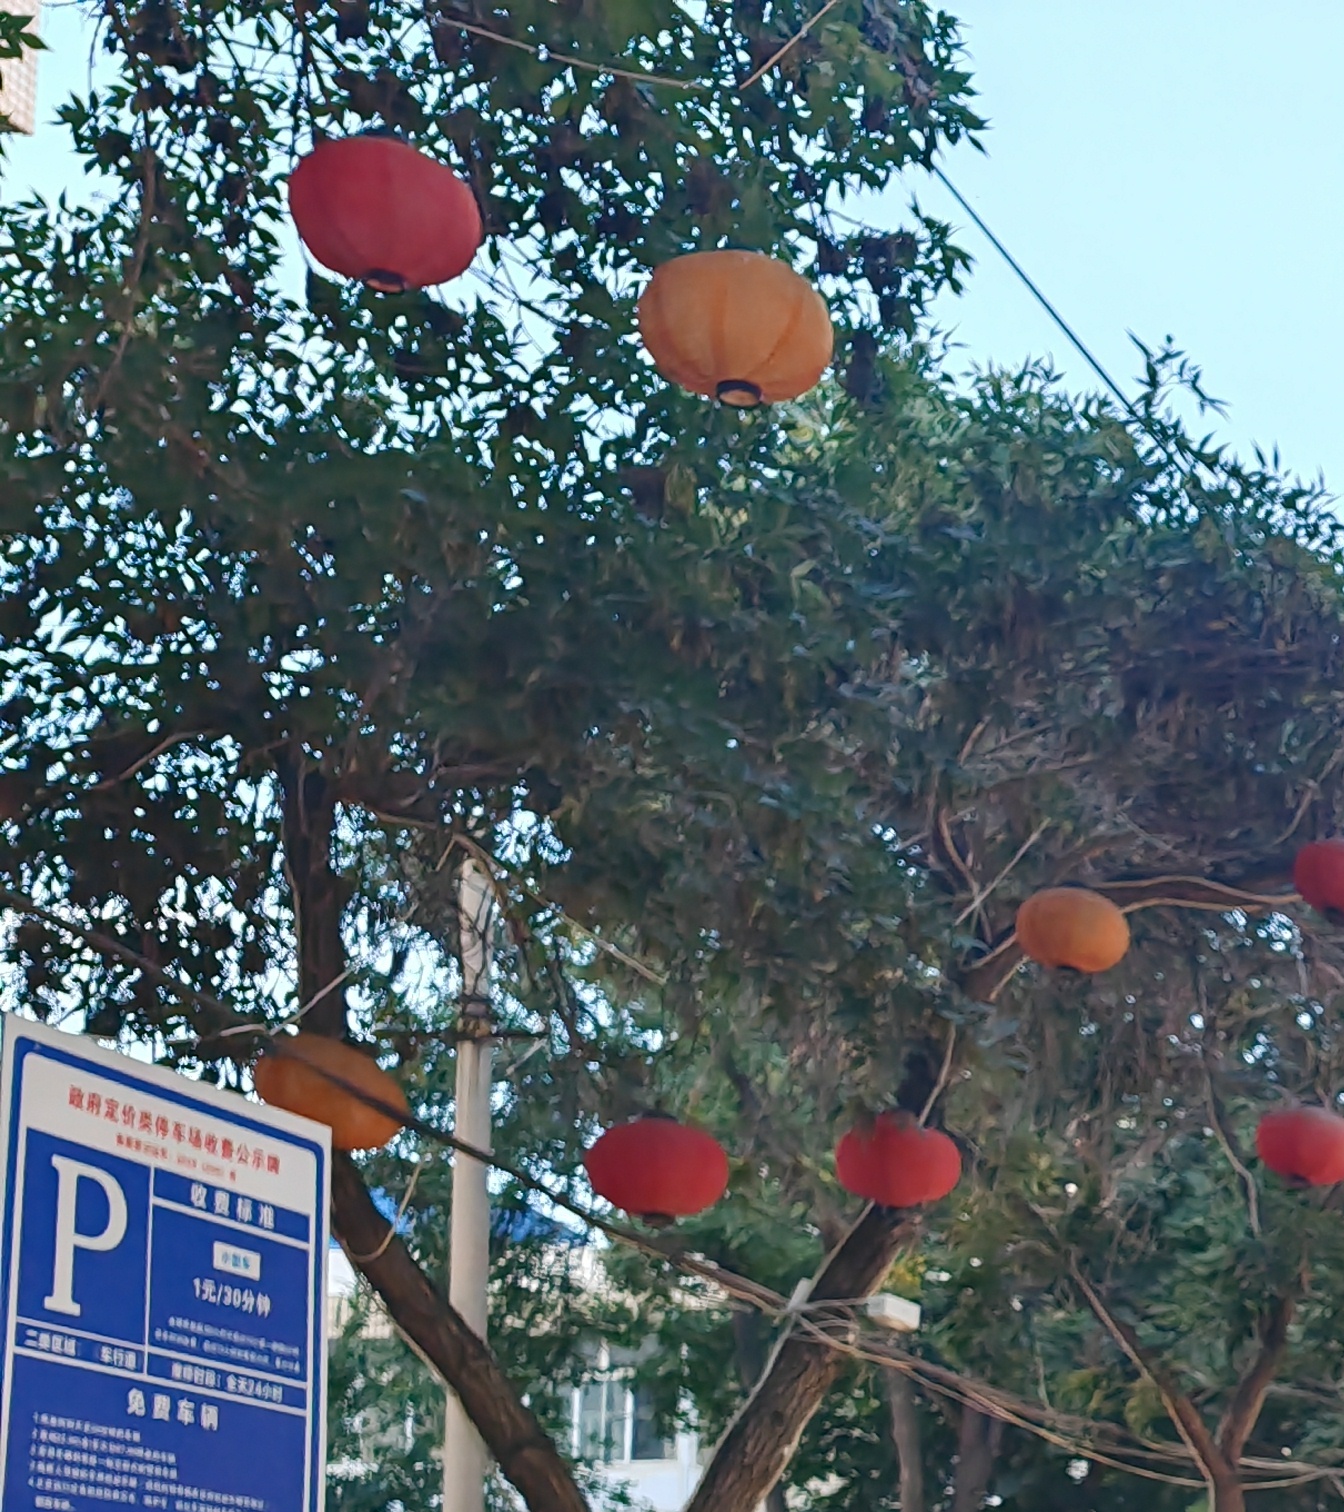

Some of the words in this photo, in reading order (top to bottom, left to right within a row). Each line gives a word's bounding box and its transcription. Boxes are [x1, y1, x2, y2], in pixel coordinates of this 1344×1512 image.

[190, 1183, 275, 1230] 收费标准
[44, 1154, 127, 1316] P
[193, 1277, 271, 1318] 1元/30分钟
